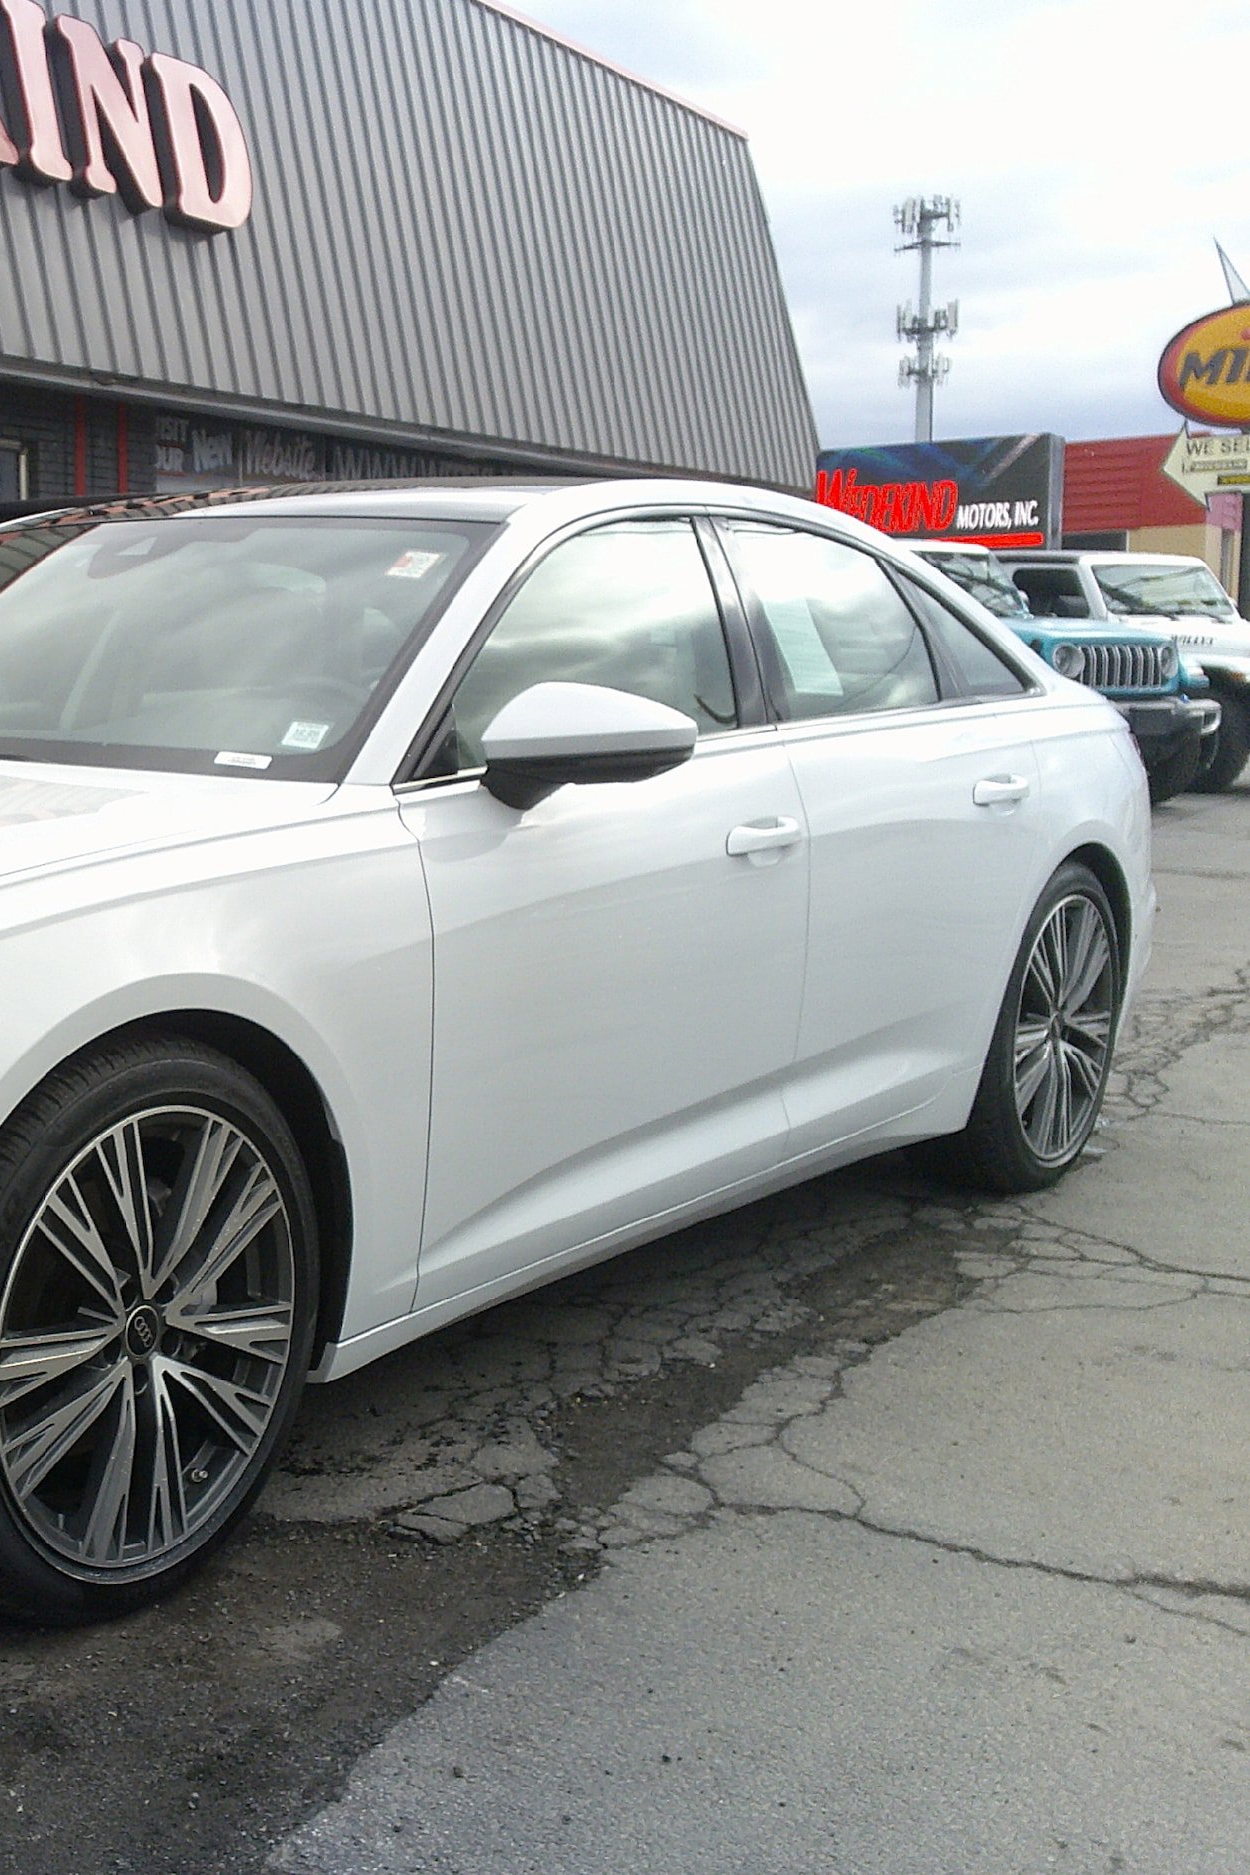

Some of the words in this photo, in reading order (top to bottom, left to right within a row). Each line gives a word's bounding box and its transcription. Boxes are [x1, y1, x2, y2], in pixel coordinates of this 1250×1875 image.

[1179, 346, 1250, 386] MI
[956, 502, 1011, 530] MOTORS,
[1014, 499, 1039, 526] INC.
